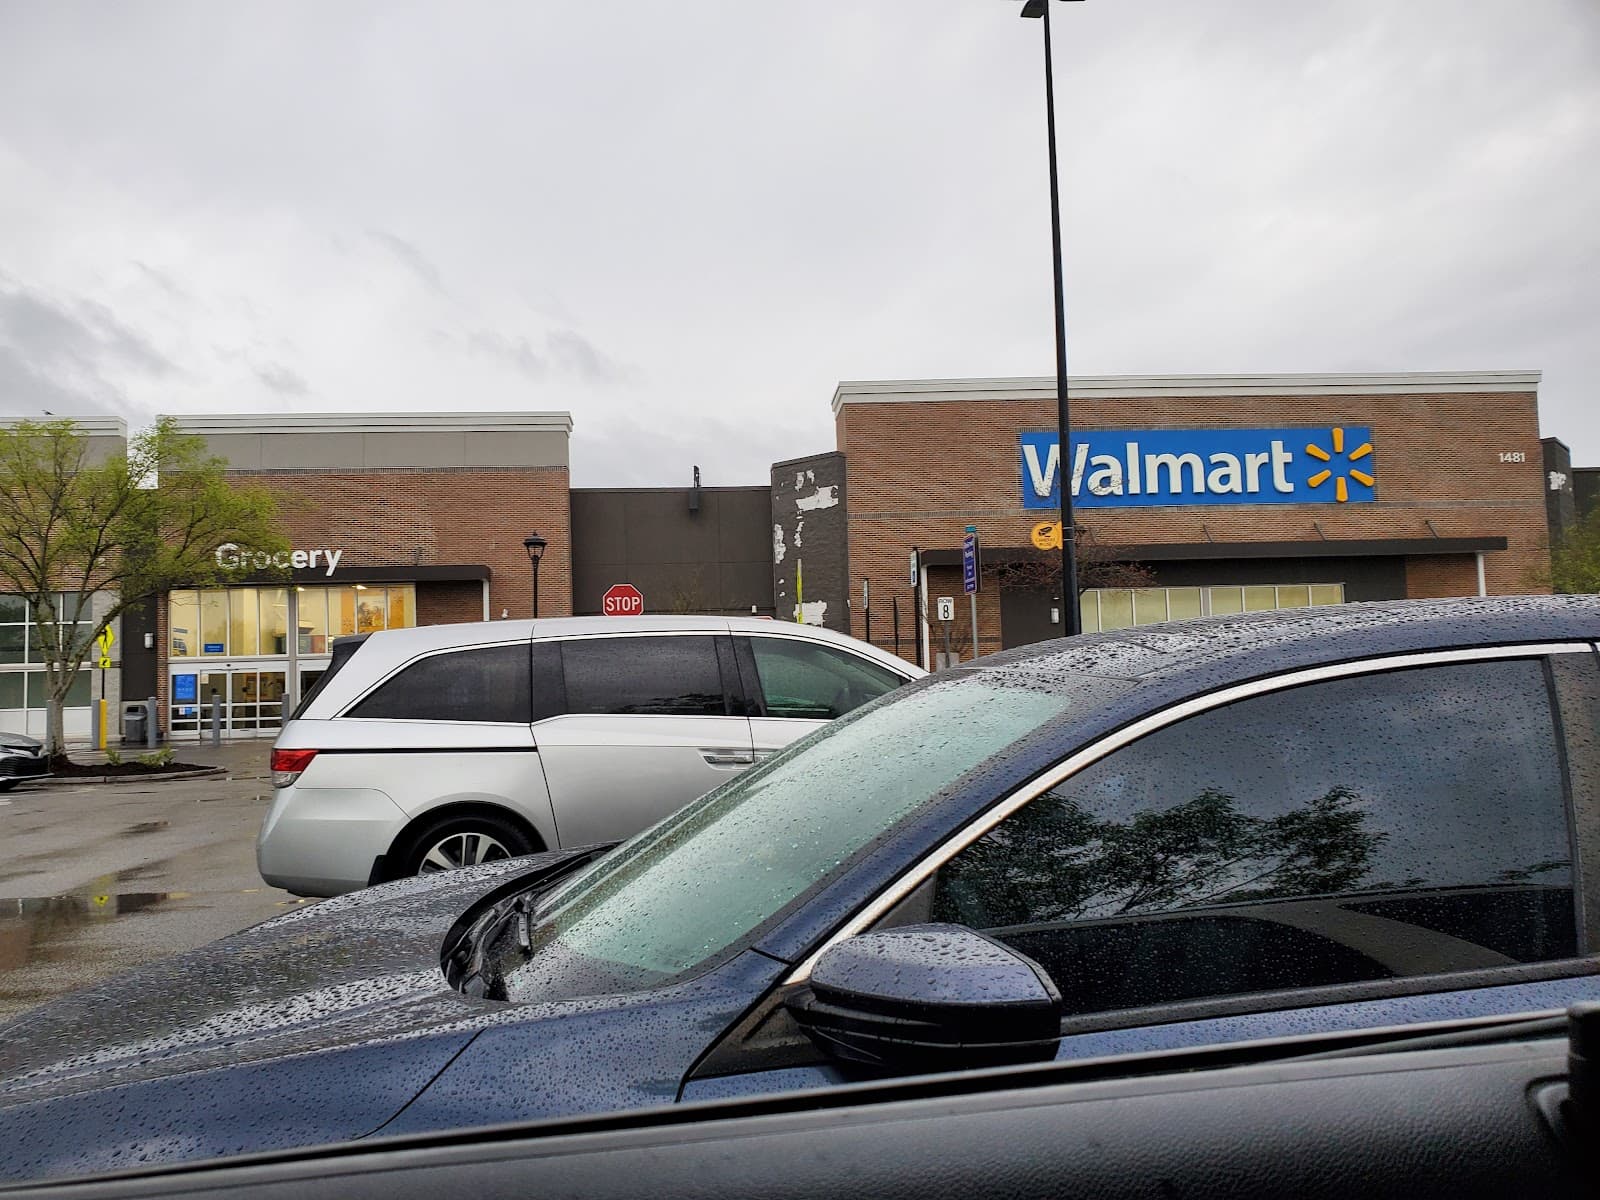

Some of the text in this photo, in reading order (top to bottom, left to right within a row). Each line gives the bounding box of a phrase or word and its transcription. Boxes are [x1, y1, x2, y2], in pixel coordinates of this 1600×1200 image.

[1498, 452, 1525, 463] 1481
[1022, 440, 1295, 497] Walmart
[215, 543, 342, 577] Grocery
[606, 596, 640, 611] STOP
[943, 604, 949, 619] 8
